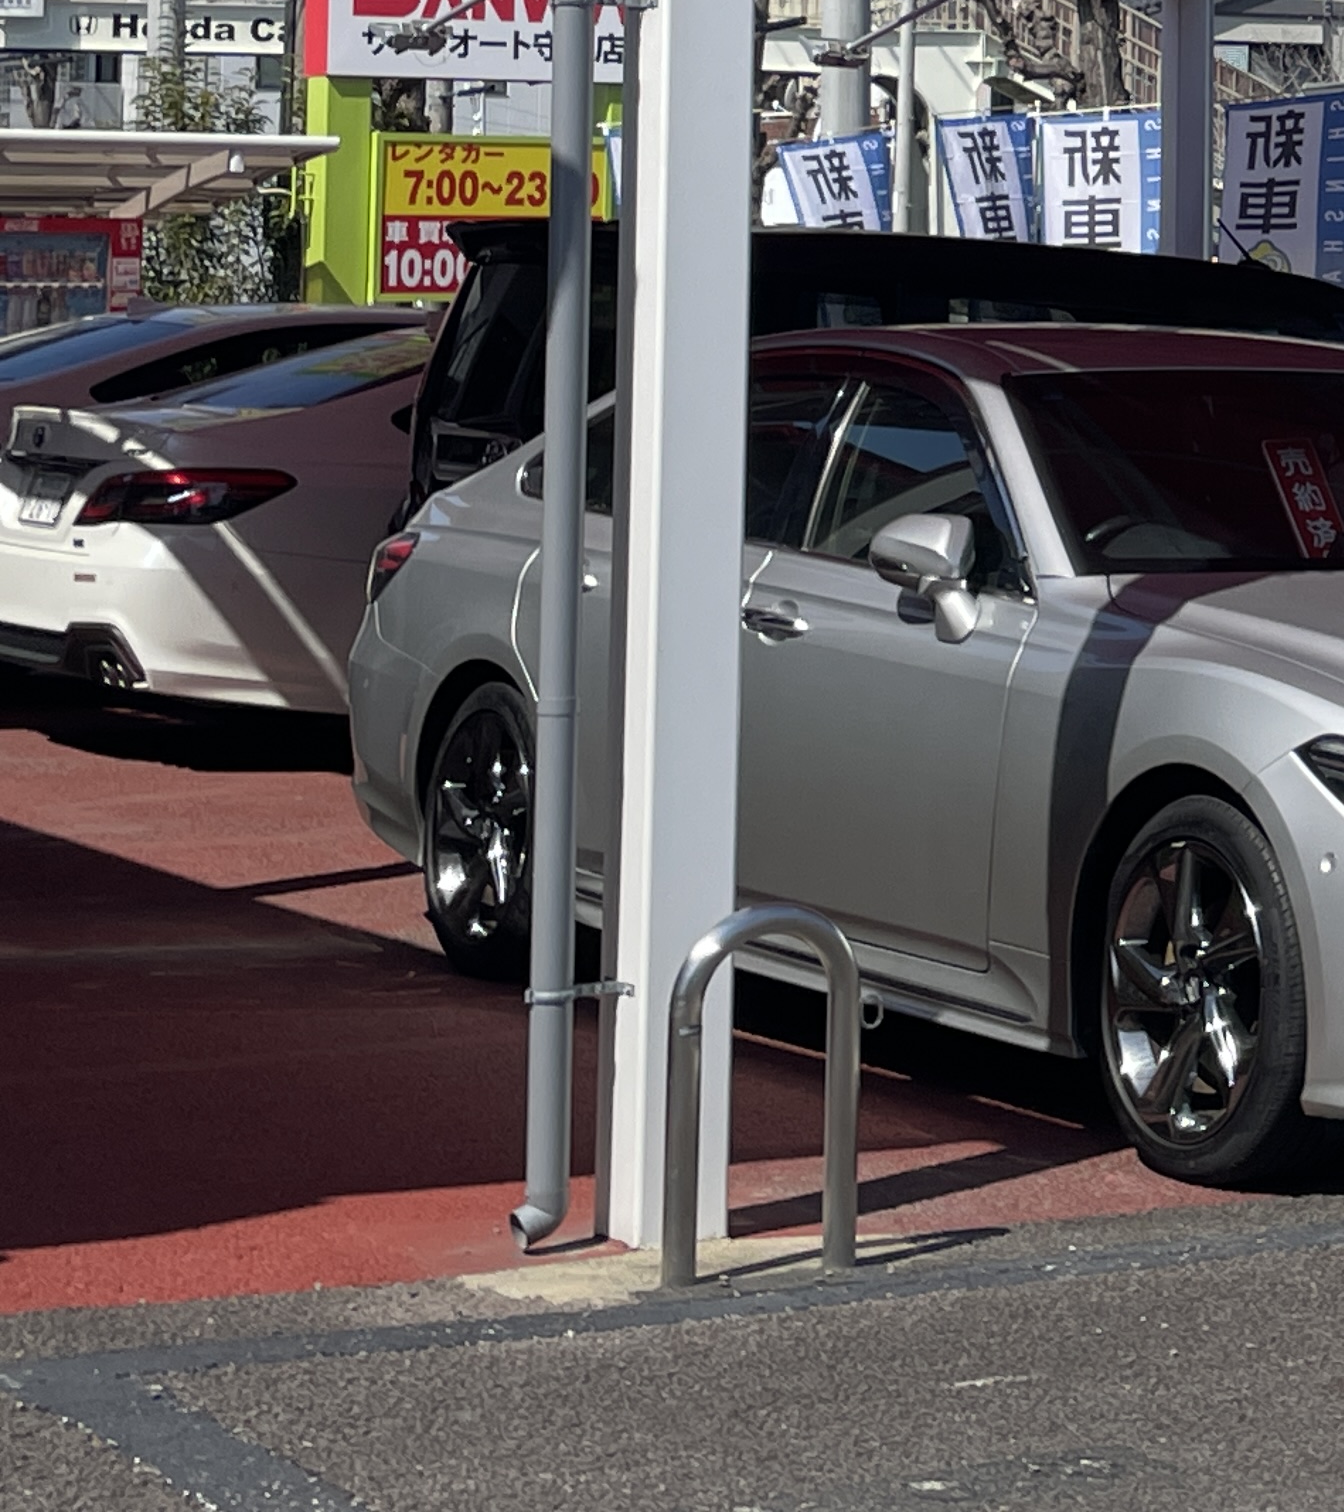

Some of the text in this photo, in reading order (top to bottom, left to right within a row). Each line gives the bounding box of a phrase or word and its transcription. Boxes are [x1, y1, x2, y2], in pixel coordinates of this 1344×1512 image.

[391, 143, 505, 165] レンタカー
